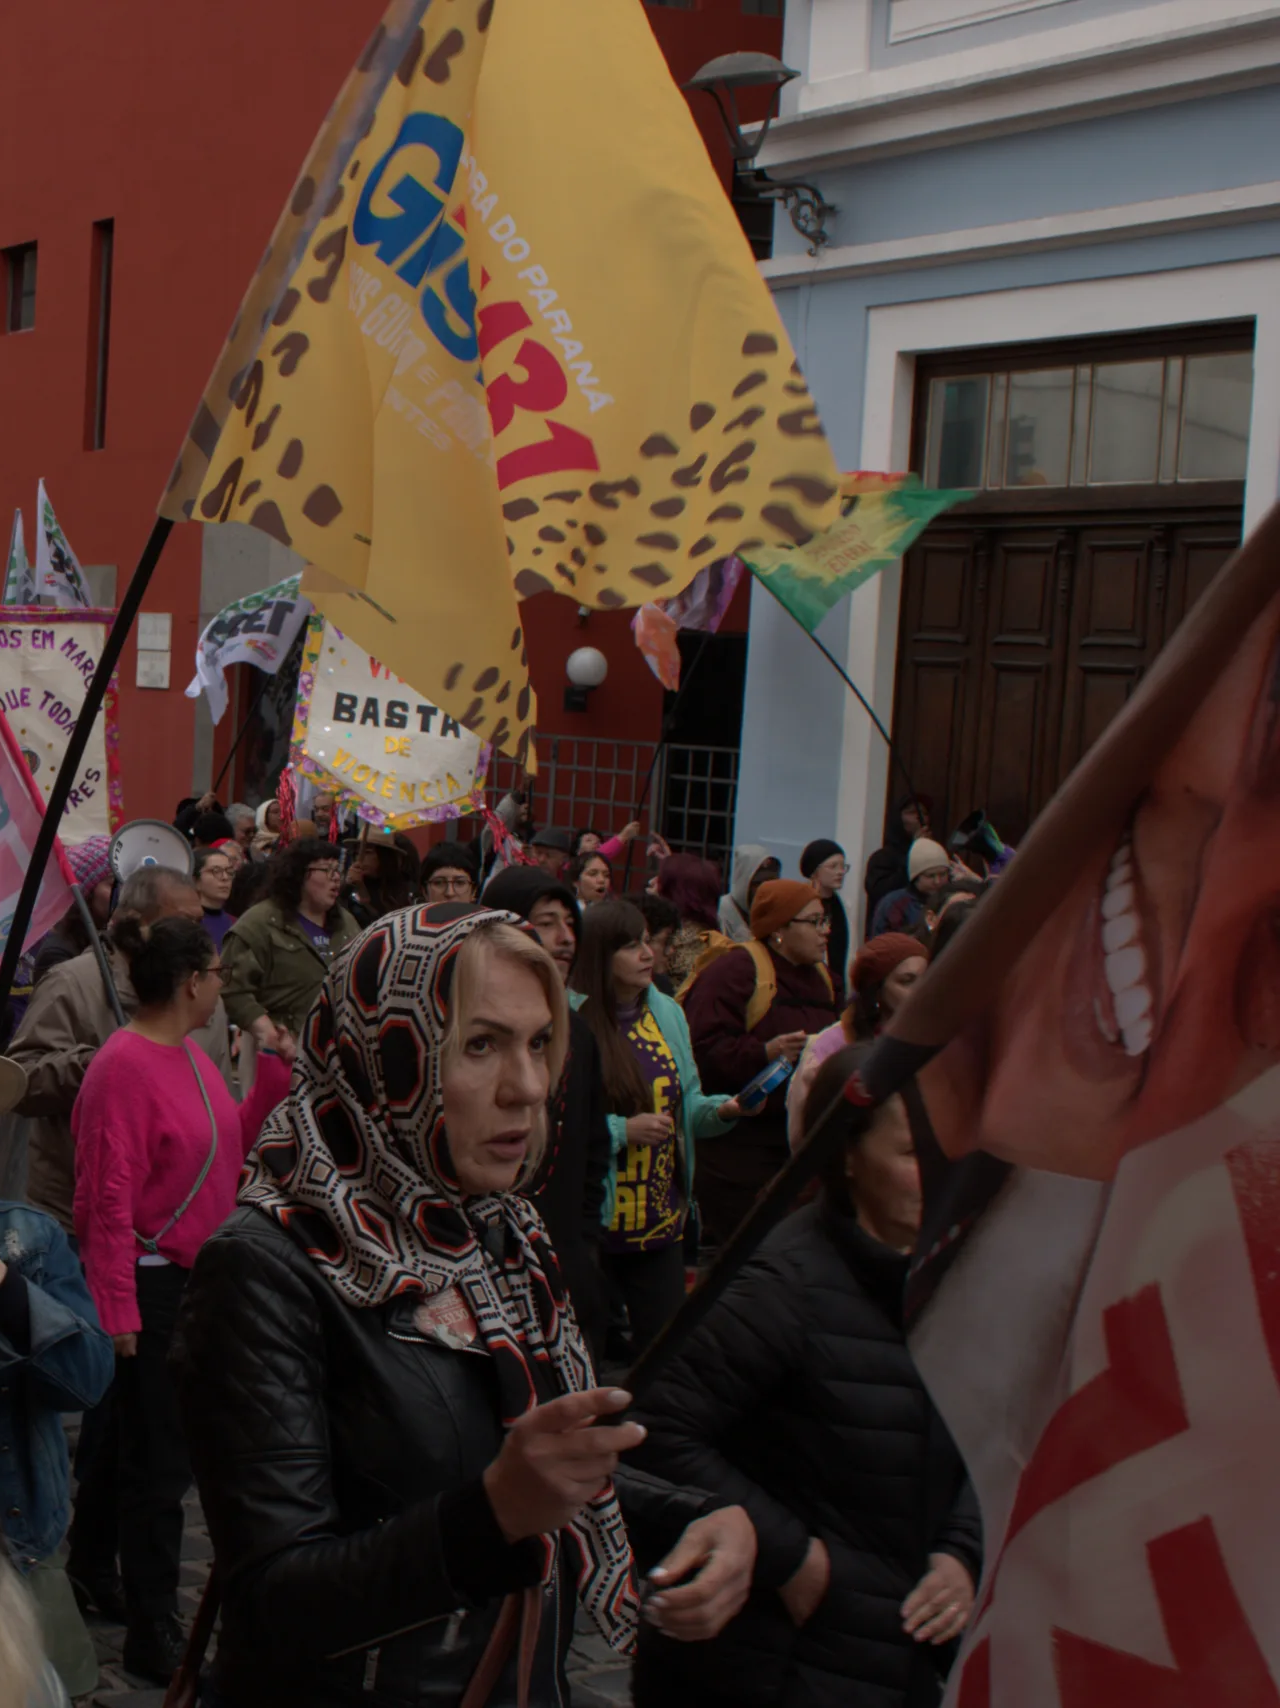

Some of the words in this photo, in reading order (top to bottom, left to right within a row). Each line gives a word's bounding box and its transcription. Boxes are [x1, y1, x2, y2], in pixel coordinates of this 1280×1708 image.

[489, 214, 530, 263] DO
[517, 264, 614, 413] PARANÁ
[32, 629, 55, 649] EM
[60, 637, 100, 700] MARC
[39, 690, 79, 736] TODA
[333, 692, 460, 738] BASTA
[384, 736, 412, 757] DE
[332, 748, 461, 803] VIOLÊNCIA
